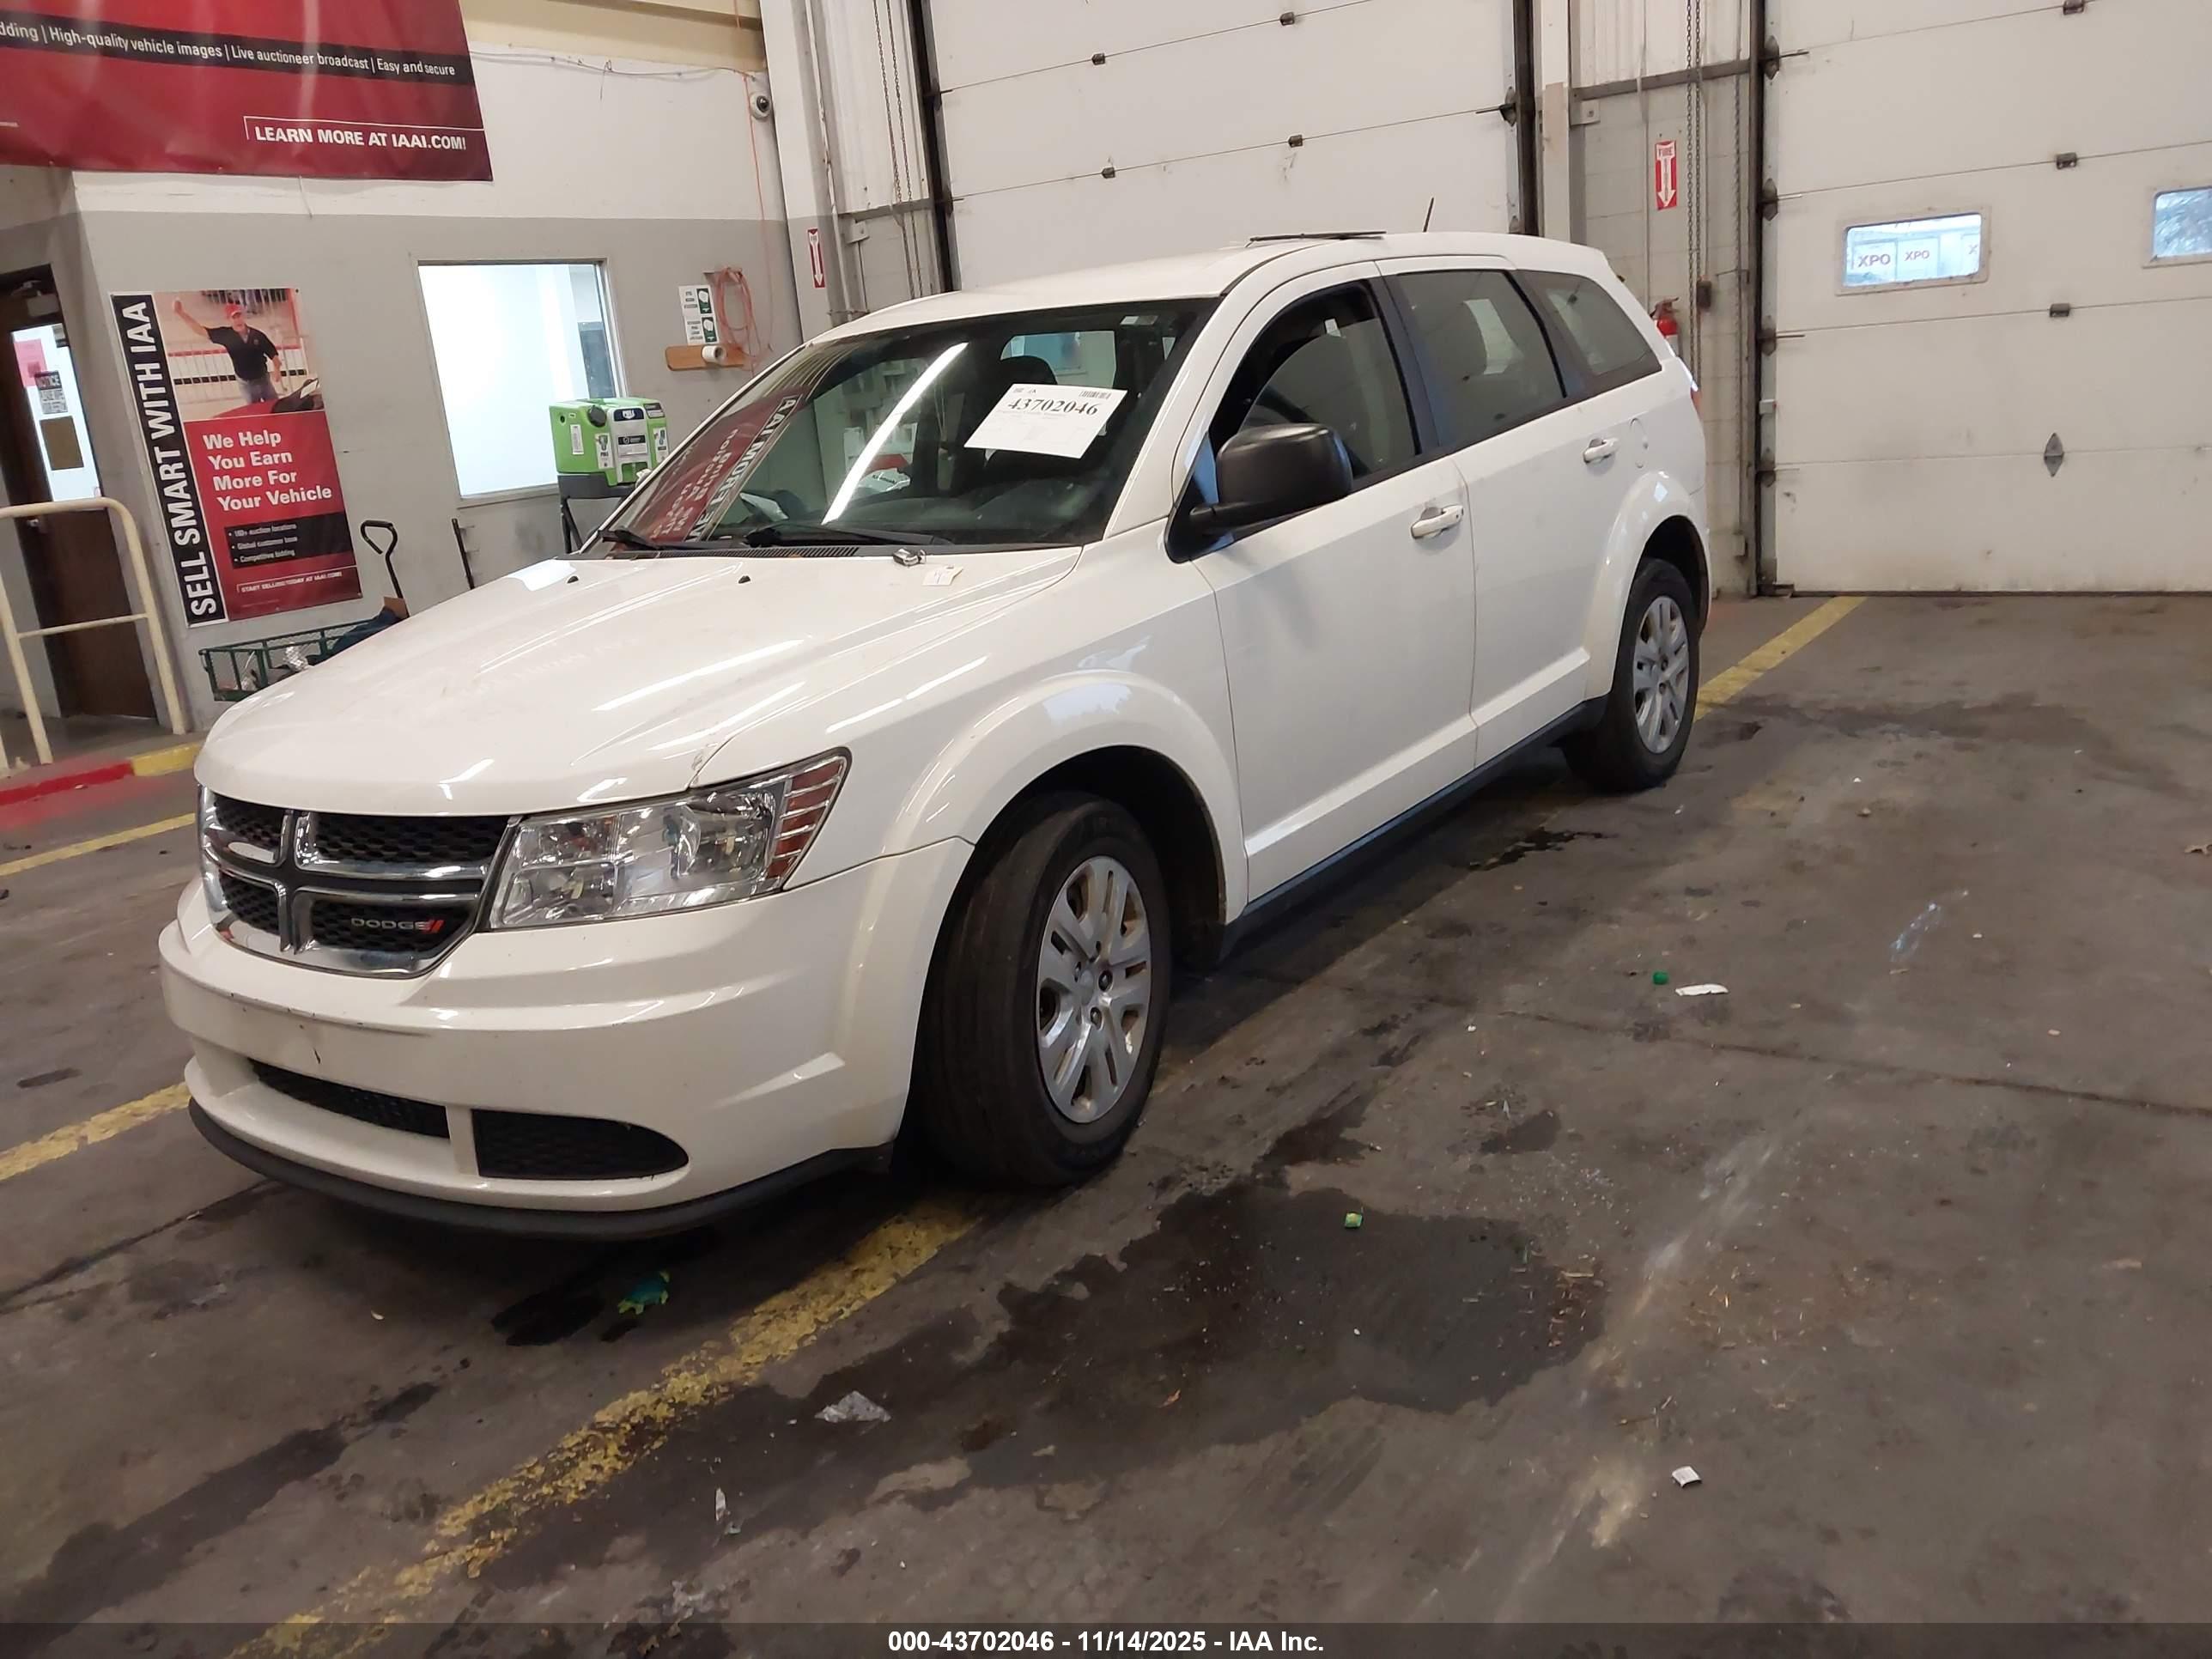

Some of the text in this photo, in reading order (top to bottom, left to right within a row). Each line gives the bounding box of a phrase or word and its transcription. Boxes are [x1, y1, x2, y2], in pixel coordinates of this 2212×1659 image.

[49, 26, 128, 52] High-quality
[131, 39, 174, 54] vehicle
[177, 41, 222, 59] images
[232, 44, 254, 60] Live
[257, 49, 313, 64] auctioneer
[317, 52, 369, 70] broadcast
[377, 59, 400, 76] Easy
[403, 62, 423, 74] and
[424, 64, 455, 76] secure
[254, 126, 466, 150] LEARN MORE AT IAAI.COM!
[1858, 253, 1891, 268] XPO
[1905, 249, 1930, 262] XPO
[1008, 398, 1100, 416] 43702046
[203, 429, 282, 450] We Help
[122, 301, 216, 616] SELL SMART WITH IAA
[208, 451, 293, 471] You Earn
[213, 470, 297, 491] More For
[216, 485, 332, 511] Your Vehicle
[350, 918, 431, 931] DODGE
